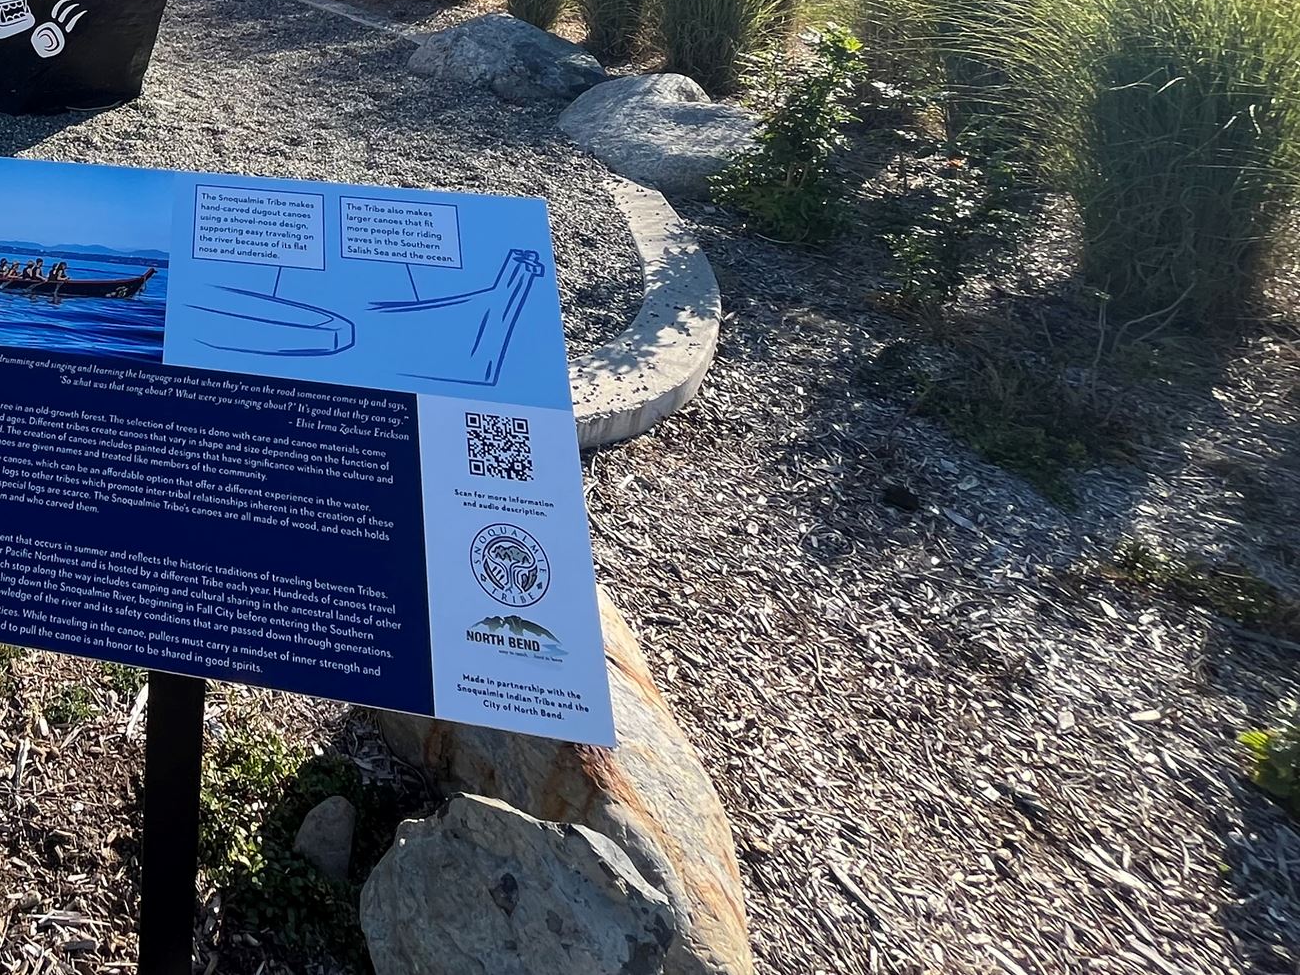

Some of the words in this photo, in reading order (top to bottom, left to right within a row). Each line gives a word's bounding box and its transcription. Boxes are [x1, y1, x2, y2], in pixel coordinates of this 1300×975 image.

[201, 192, 216, 200] The
[218, 194, 264, 204] Snoqualmie
[267, 198, 286, 206] Tribe
[201, 203, 250, 213] hand-carved
[251, 207, 280, 217] dugout
[346, 203, 362, 211] The
[364, 204, 385, 212] Tribe
[387, 206, 404, 214] also
[406, 208, 432, 217] makes
[200, 214, 221, 223] using
[230, 216, 277, 226] shovel-nose
[279, 220, 308, 230] design,
[346, 213, 371, 223] larger
[373, 217, 402, 225] canoes
[404, 218, 422, 226] that
[424, 220, 433, 228] fit
[200, 226, 243, 235] supporting
[265, 230, 301, 241] traveling
[370, 228, 399, 236] people
[402, 228, 414, 236] for
[417, 230, 441, 241] riding
[199, 234, 212, 242] the
[235, 237, 268, 247] because
[294, 242, 306, 250] flat
[384, 238, 398, 246] the
[400, 239, 440, 249] Southern
[237, 249, 279, 258] underside.
[347, 245, 371, 254] Salish
[374, 248, 389, 256] Sea
[409, 251, 423, 259] the
[73, 377, 91, 387] what
[108, 381, 124, 390] that
[126, 386, 143, 395] song
[144, 385, 173, 396] about?
[175, 388, 196, 399] What
[198, 394, 217, 405] were
[216, 396, 232, 405] you
[234, 399, 262, 410] singing
[311, 407, 332, 416] good
[333, 408, 350, 418] that
[352, 410, 369, 422] they
[296, 417, 314, 429] Elsie
[317, 420, 337, 432] Irma
[339, 423, 371, 435] Zackuse
[374, 427, 409, 440] Erickson
[9, 493, 25, 502] and
[26, 495, 44, 505] who
[45, 499, 74, 509] carved
[76, 501, 99, 513] them.
[508, 496, 554, 507] information
[501, 504, 547, 516] description.
[474, 527, 547, 573] SNOQUALMIE
[492, 586, 536, 604] TRIBE
[466, 630, 505, 646] NORTH
[508, 637, 541, 652] BEND
[462, 674, 484, 683] Made
[487, 677, 494, 685] in
[497, 681, 545, 695] partnership
[547, 688, 564, 696] with
[567, 691, 581, 699] the
[457, 683, 503, 698] Snoqualmie
[506, 692, 531, 702] Indian
[534, 696, 555, 706] Tribe
[558, 701, 572, 709] and
[575, 703, 589, 712] the
[483, 699, 500, 711] City
[503, 703, 511, 711] of
[514, 705, 538, 715] North
[540, 709, 564, 720] Bend.
